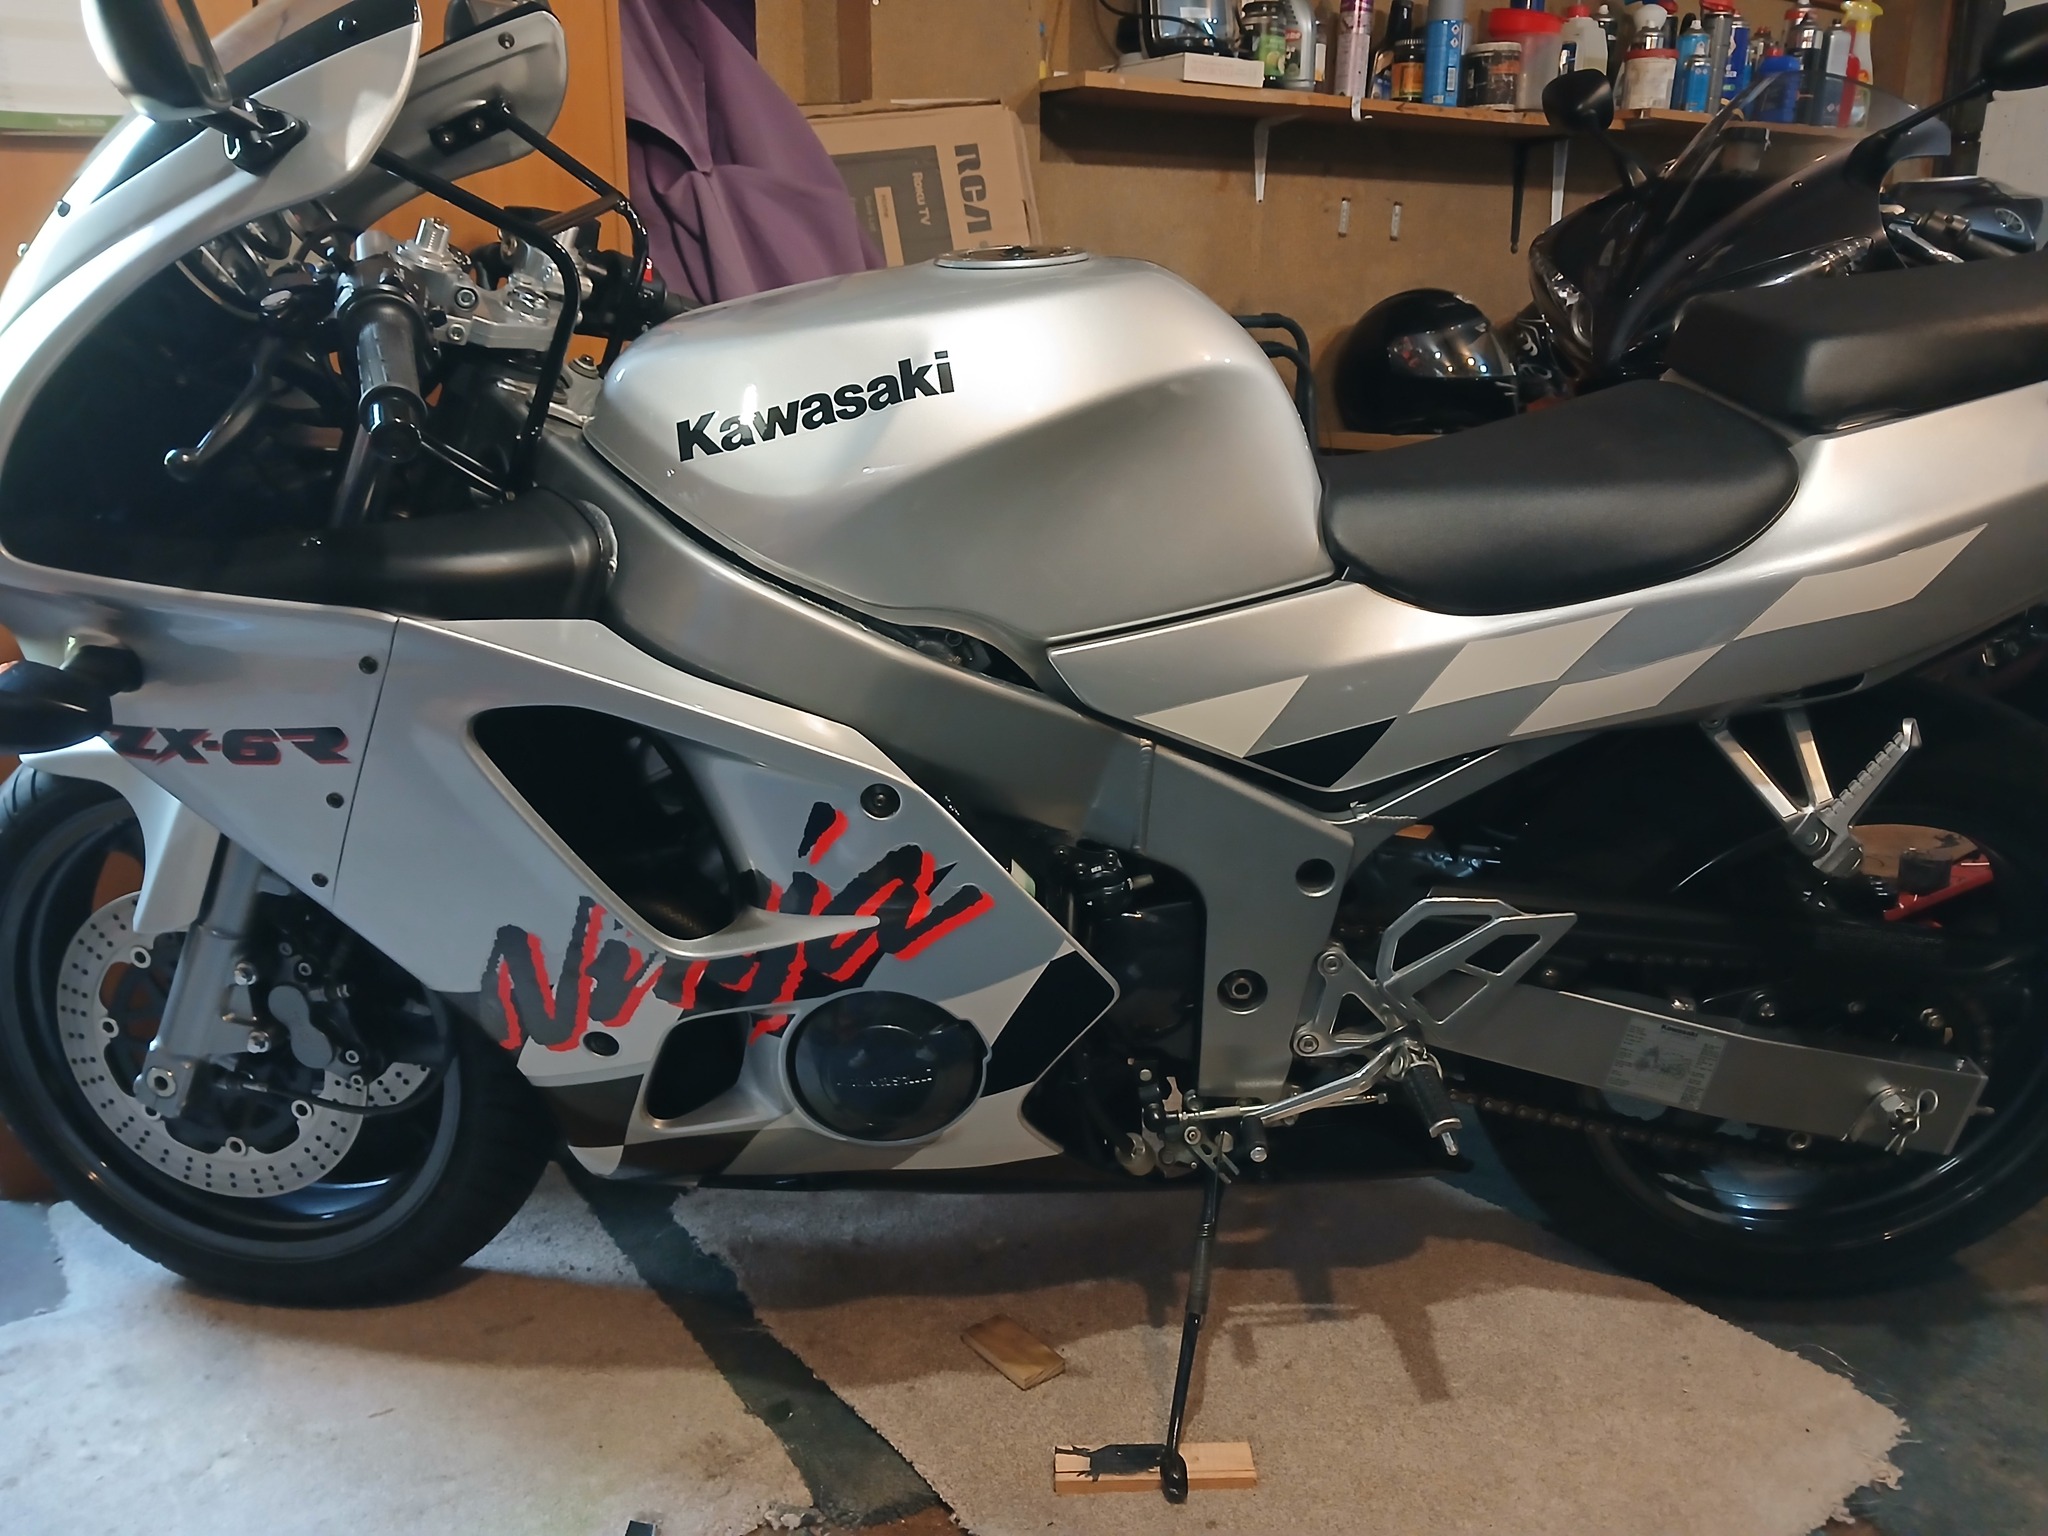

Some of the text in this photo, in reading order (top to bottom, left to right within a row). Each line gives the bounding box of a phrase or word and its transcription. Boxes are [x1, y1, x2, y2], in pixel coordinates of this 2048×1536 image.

[918, 207, 932, 225] TV
[954, 143, 992, 234] RCA
[676, 350, 955, 462] Kawasaki
[105, 724, 352, 765] ZX-6R
[480, 801, 995, 1051] Ninja
